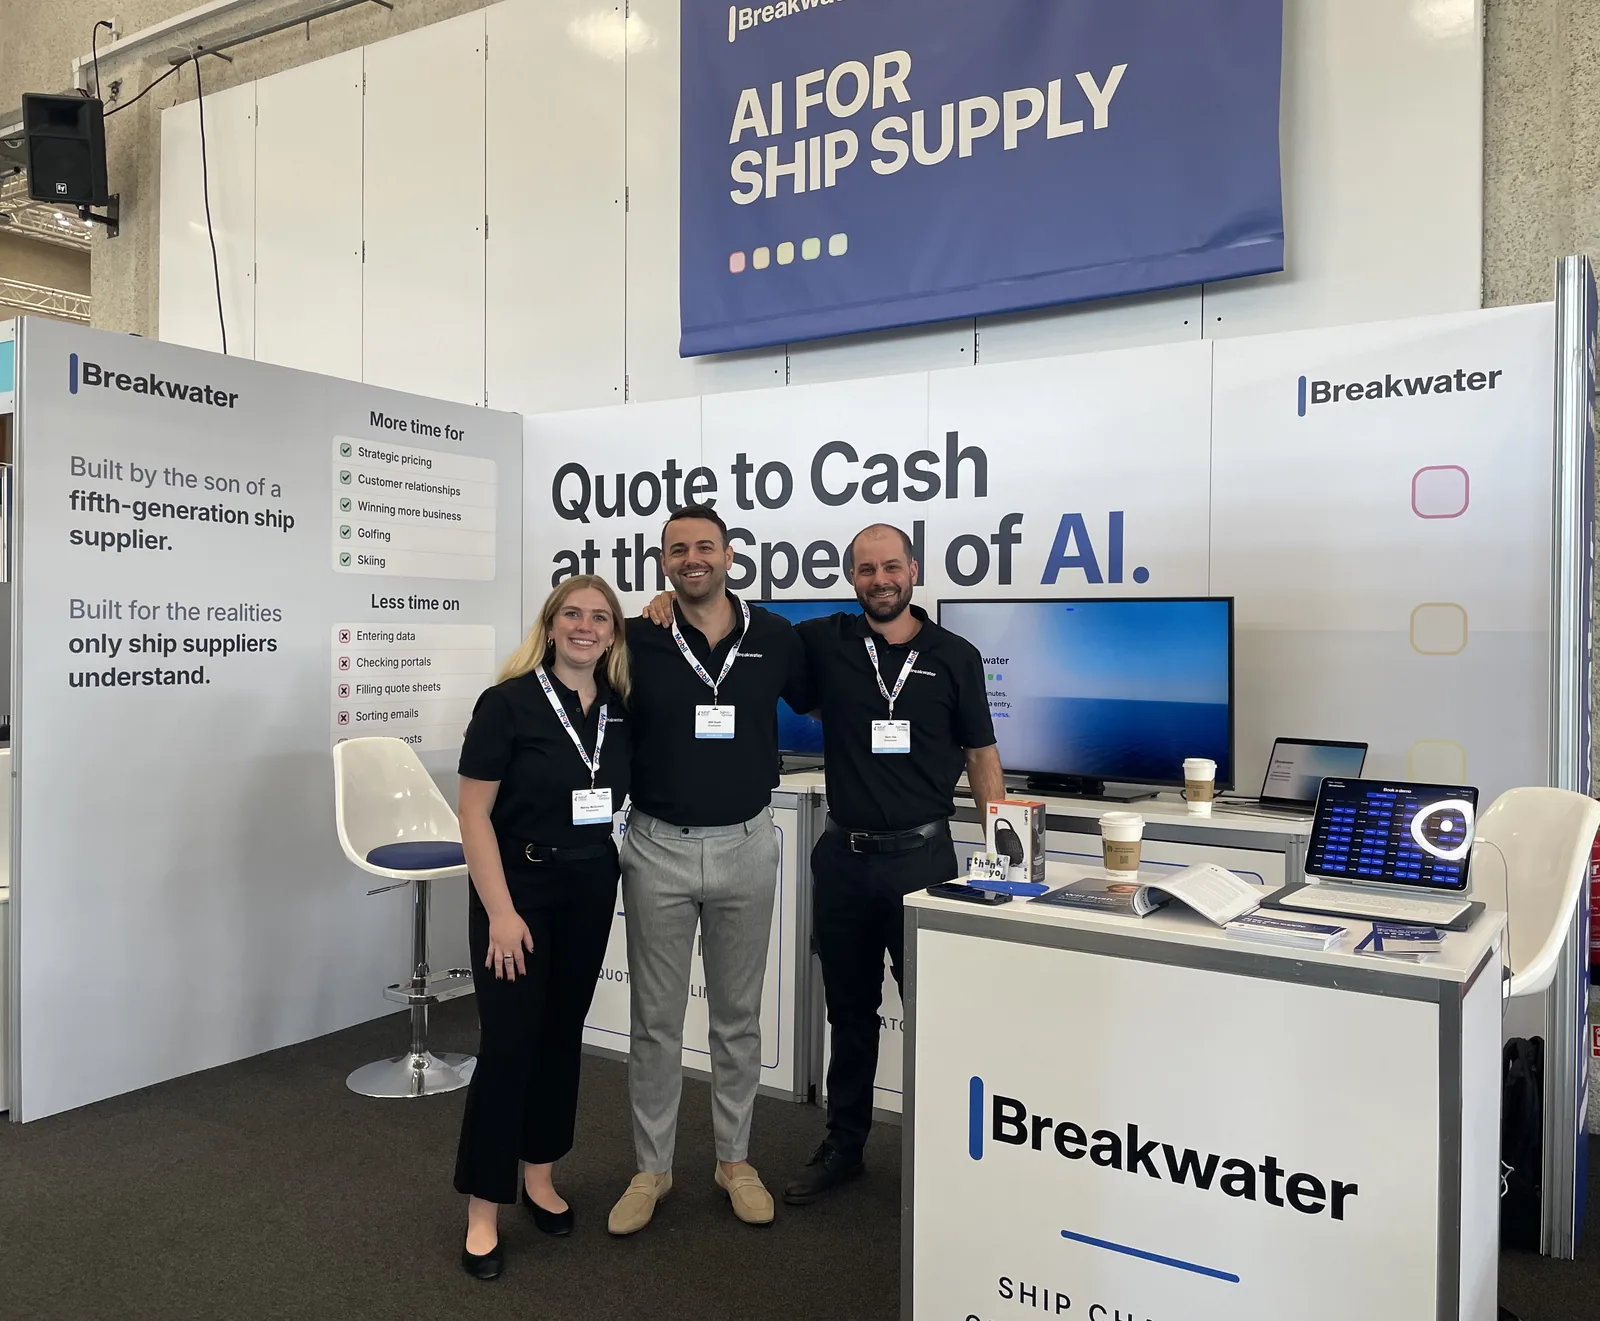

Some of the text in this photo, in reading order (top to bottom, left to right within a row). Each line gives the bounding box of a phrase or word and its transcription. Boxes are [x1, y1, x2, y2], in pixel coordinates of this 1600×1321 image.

[738, 0, 848, 31] Breakw
[729, 49, 912, 144] AI FOR
[729, 63, 1128, 206] SHIP SUPPLY
[82, 361, 239, 408] Breakwater
[1310, 368, 1503, 404] Breakwater
[370, 411, 465, 441] More time for
[358, 447, 432, 469] Strategic pricing
[70, 455, 282, 498] Built by the son of a
[358, 474, 461, 497] Customer relationships
[552, 430, 988, 523] Quote to Cash
[69, 489, 295, 533] fifth-generation ship
[358, 501, 462, 521] Winning more business
[69, 528, 173, 553] supplier.
[357, 528, 391, 543] Golfing
[357, 555, 386, 569] Skiing
[551, 510, 1150, 600] at th Spe of AI.
[69, 598, 282, 622] Built for the realities
[371, 593, 460, 611] Less time on
[68, 633, 277, 658] only ship suppliers
[356, 630, 416, 643] Entering data
[674, 633, 688, 653] Mobil
[356, 657, 432, 671] Checking portals
[906, 650, 920, 665] Mob
[982, 656, 1010, 665] water
[68, 665, 211, 688] understand.
[539, 673, 553, 693] Mobil
[694, 664, 711, 684] Mobil
[356, 682, 441, 696] Filling quote sheets
[891, 679, 904, 698] Mobil
[355, 708, 419, 722] Sorting emails
[556, 708, 571, 728] Mobil
[577, 743, 590, 764] Mobil
[974, 856, 1002, 869] thank
[988, 869, 1006, 880] you
[598, 967, 630, 984] QUOT
[992, 1093, 1359, 1221] Breakwater
[998, 1276, 1071, 1315] SHIP
